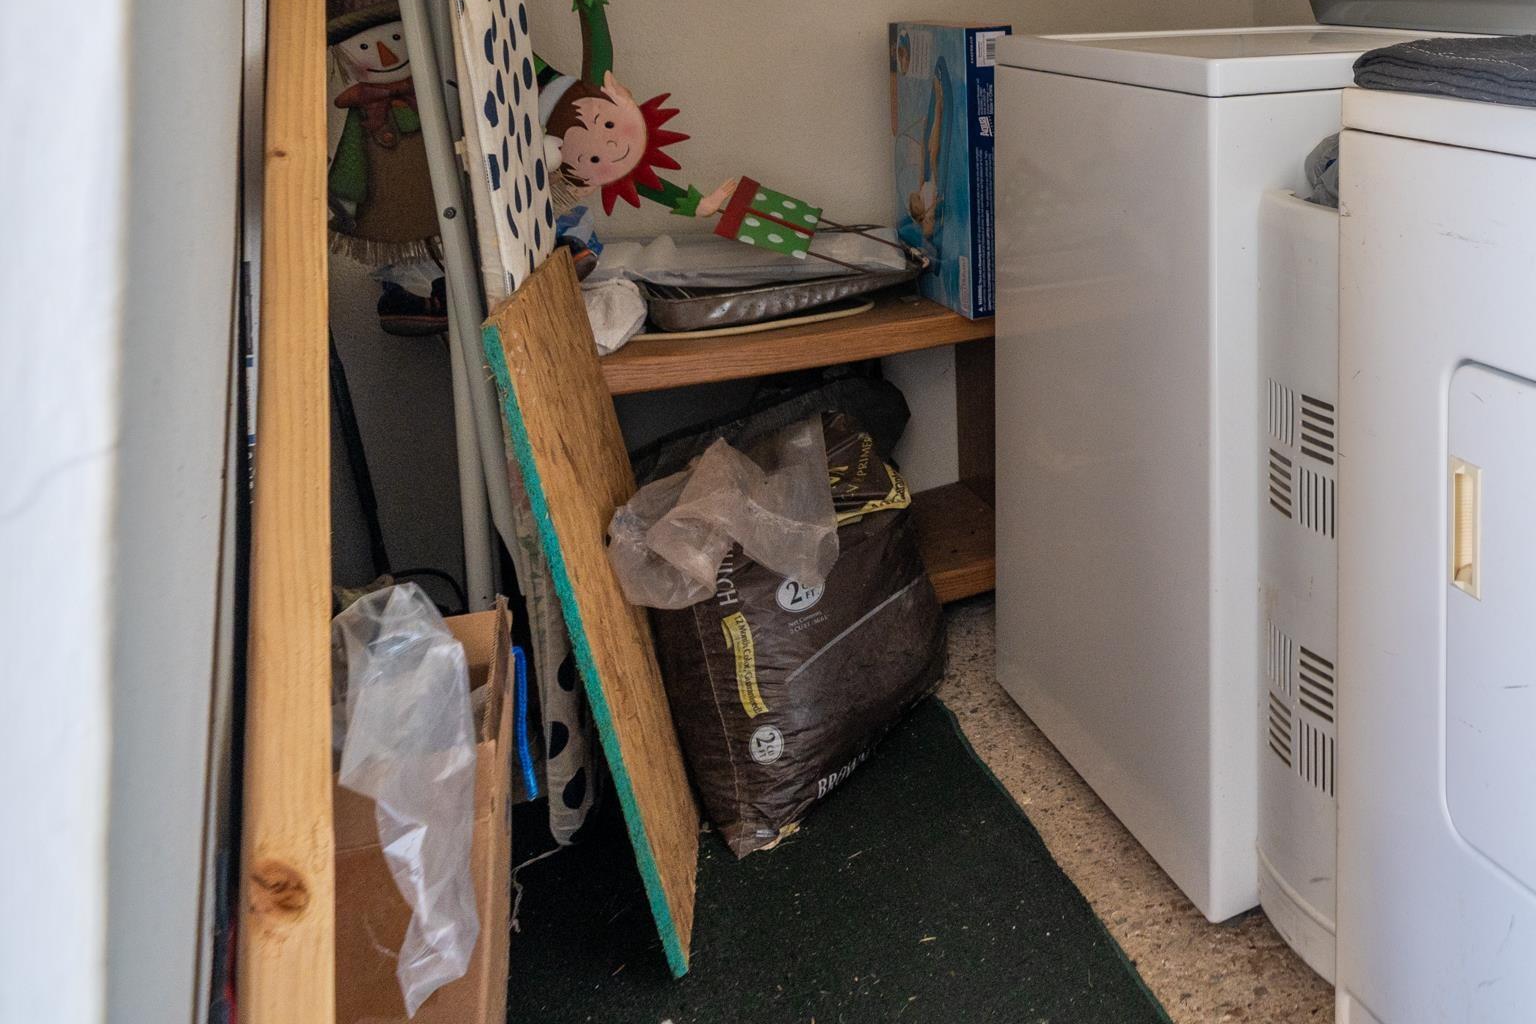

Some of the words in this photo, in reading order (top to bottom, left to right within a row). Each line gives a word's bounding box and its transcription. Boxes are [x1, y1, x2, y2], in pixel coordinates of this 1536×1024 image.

[786, 580, 803, 606] 2
[734, 614, 744, 625] 12
[756, 732, 776, 748] 2
